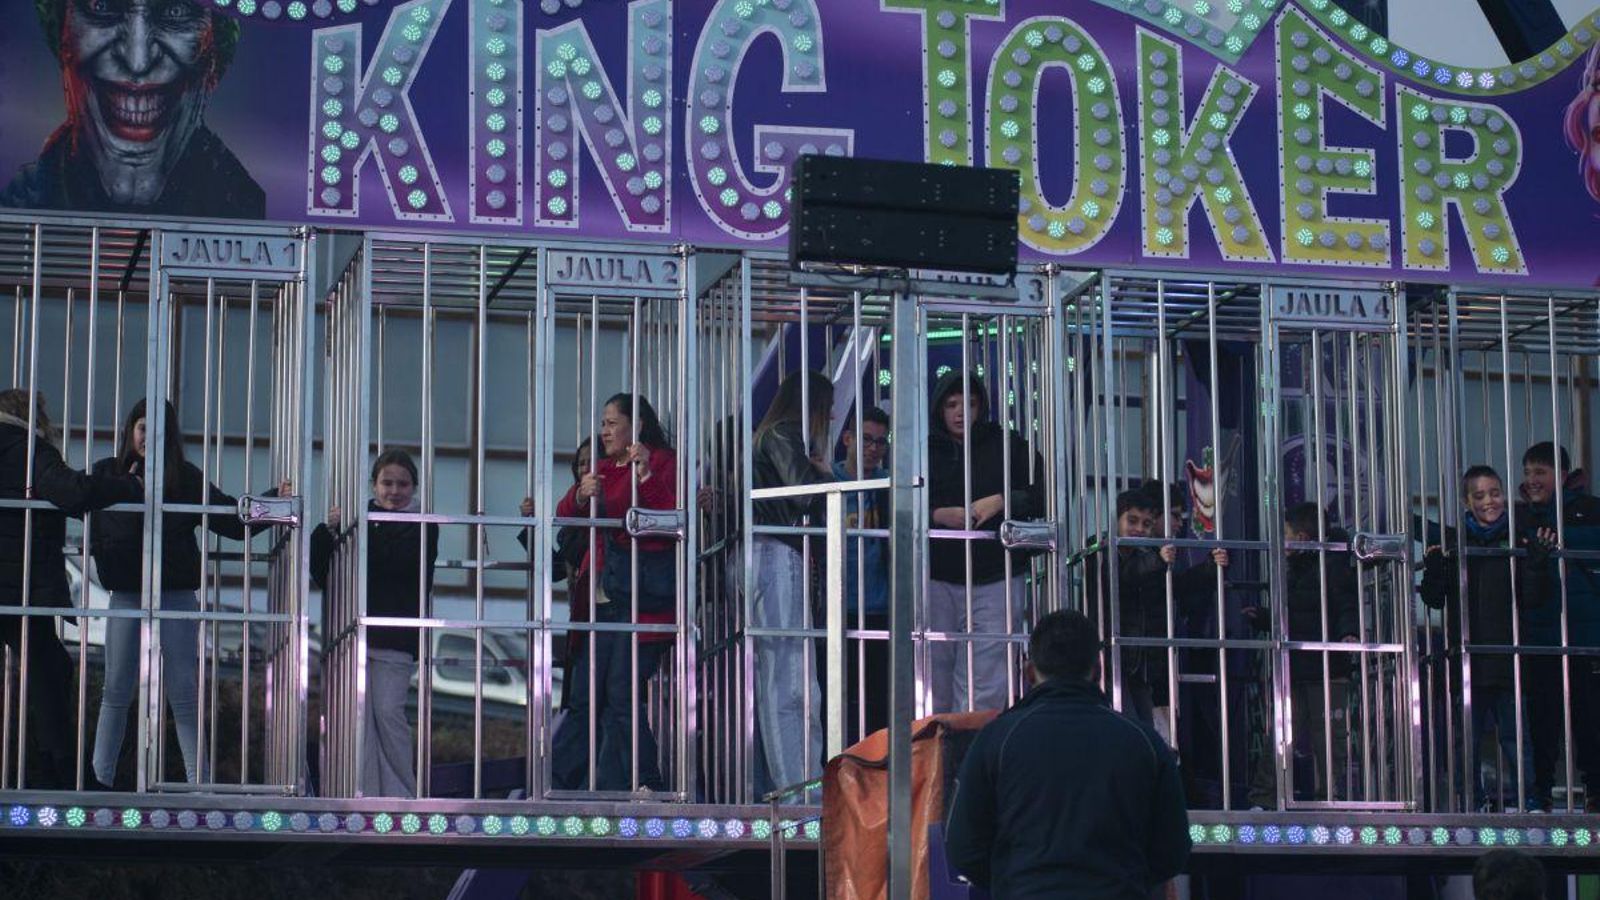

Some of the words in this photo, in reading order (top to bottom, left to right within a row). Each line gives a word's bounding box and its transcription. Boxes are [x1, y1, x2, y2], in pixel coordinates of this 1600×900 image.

[307, 0, 854, 240] KING
[172, 237, 272, 266] JAULA
[283, 242, 296, 266] 1
[557, 256, 653, 284] JAULA
[662, 260, 678, 285] 2
[1028, 278, 1044, 302] 3
[1279, 292, 1368, 318] JAULA
[1374, 295, 1390, 319] 4
